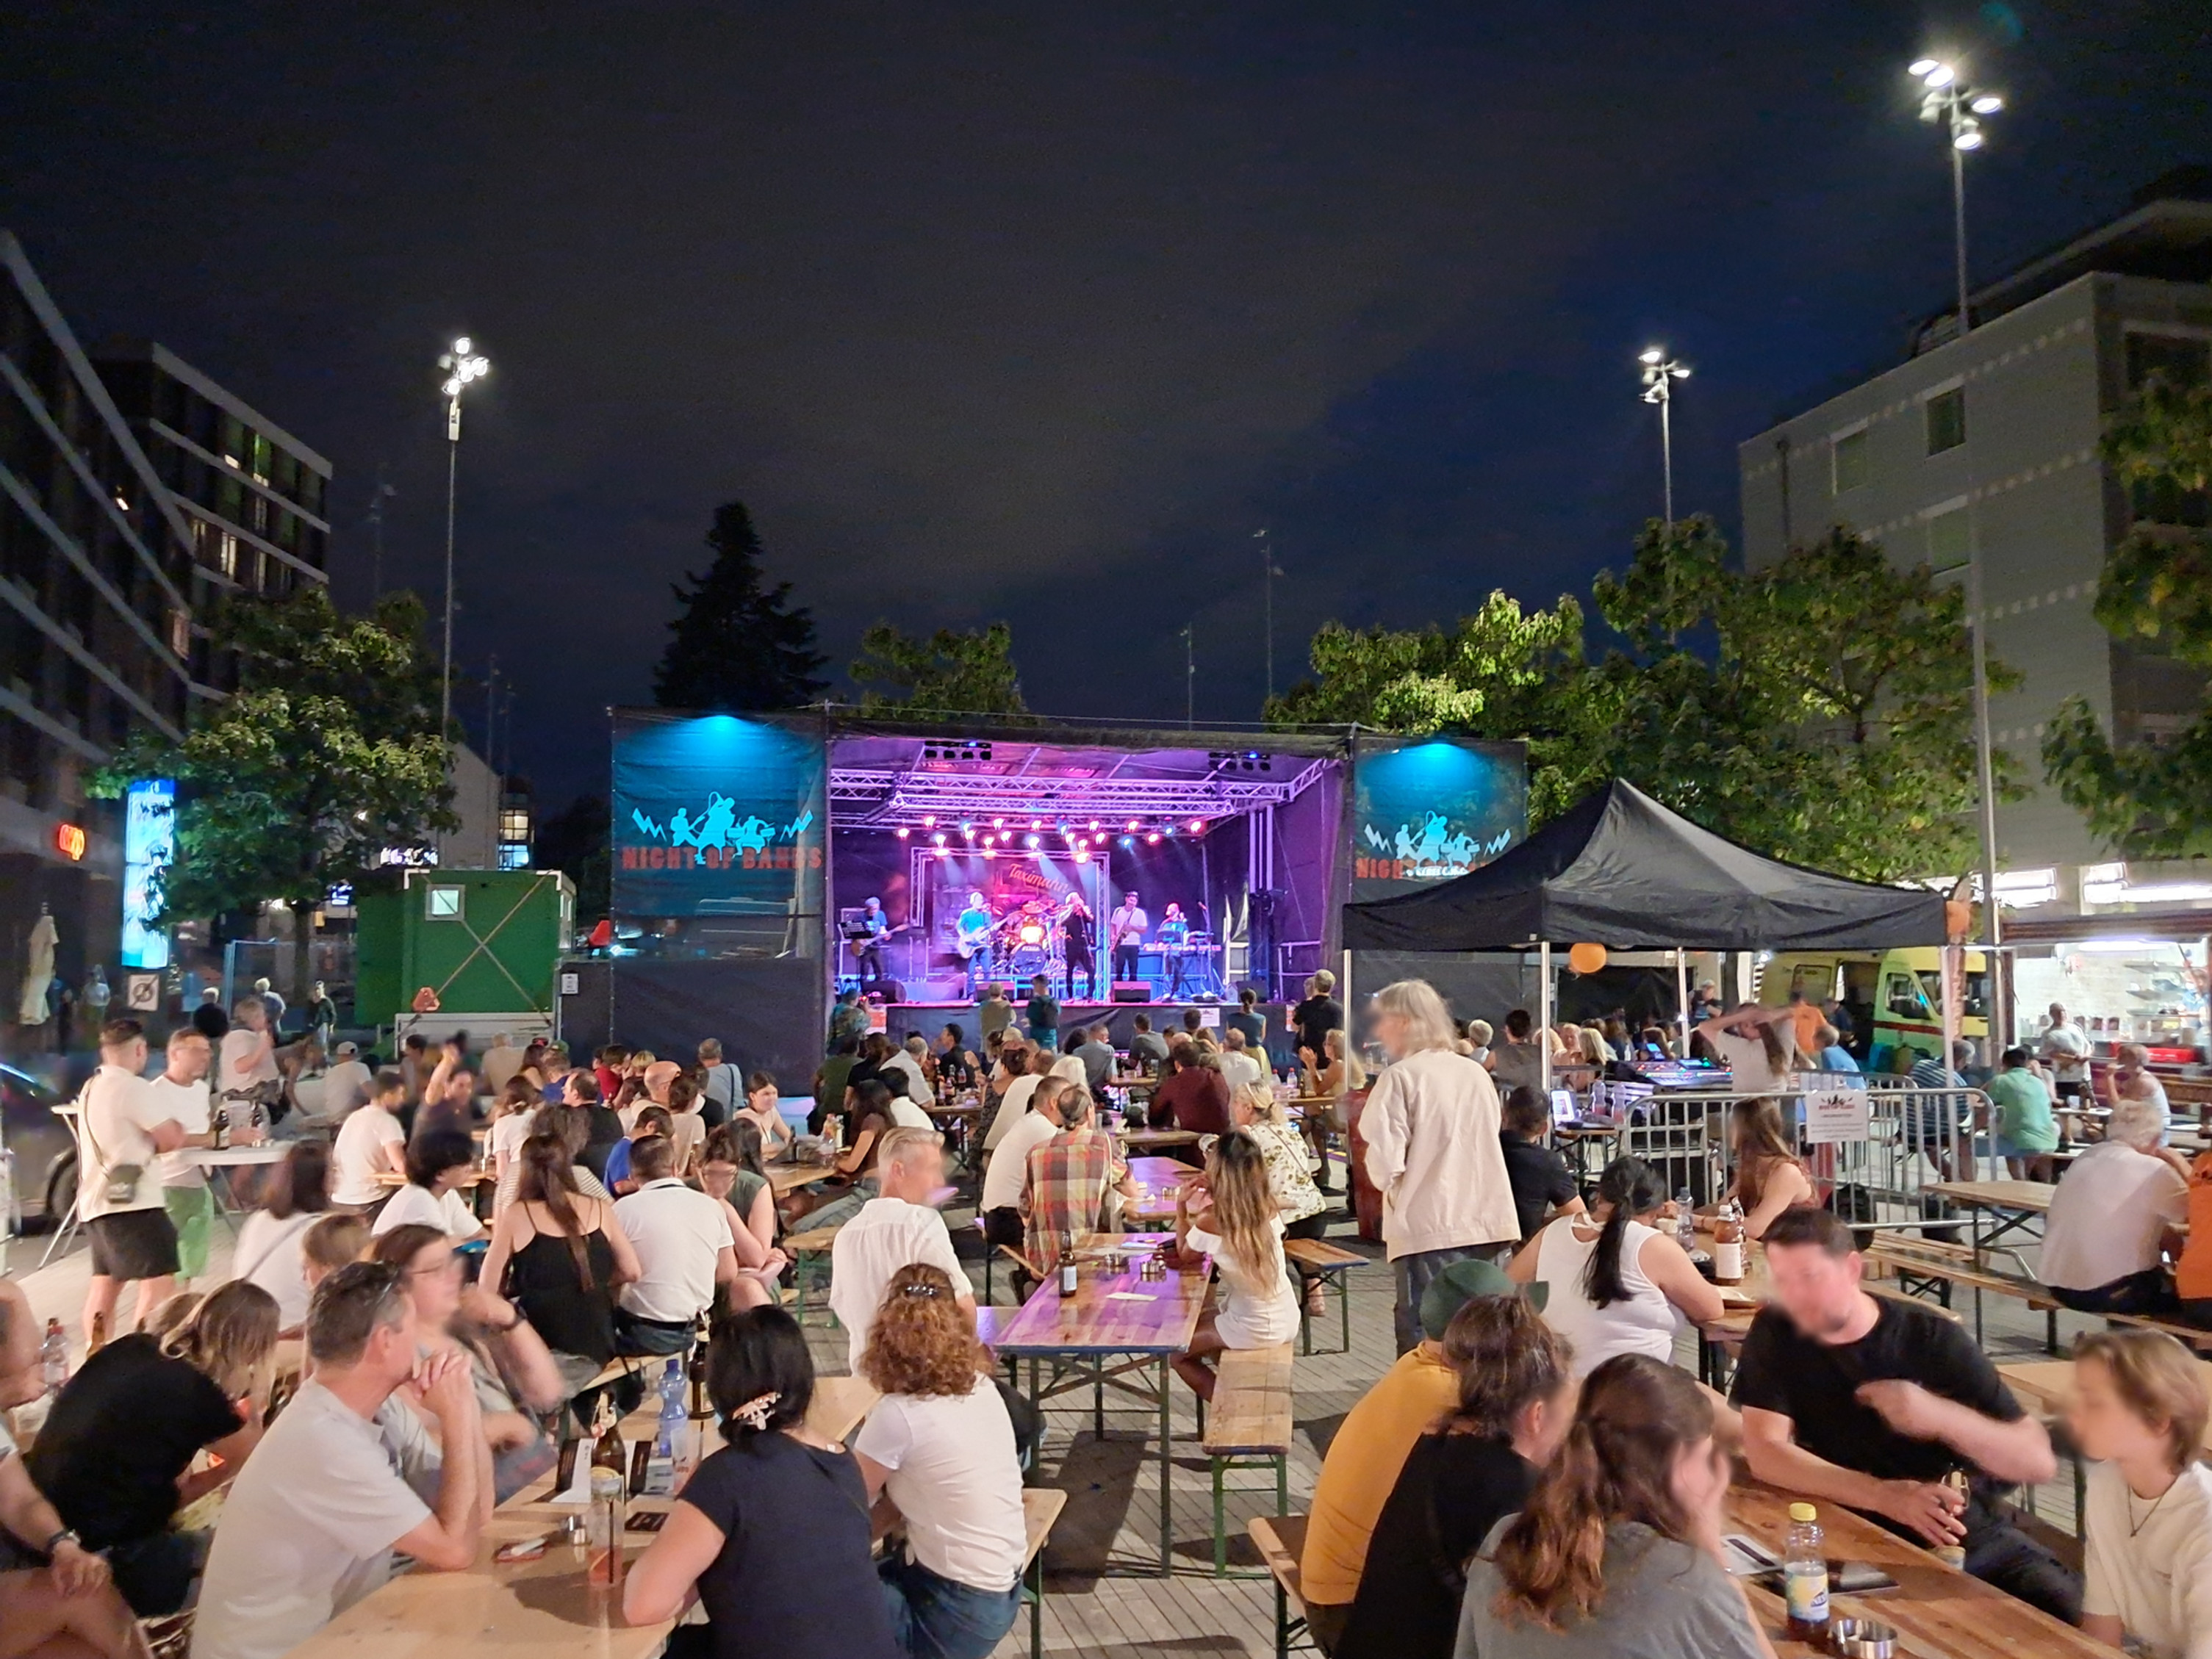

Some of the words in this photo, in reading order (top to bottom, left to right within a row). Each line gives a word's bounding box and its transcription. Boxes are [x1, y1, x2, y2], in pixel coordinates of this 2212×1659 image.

[622, 847, 697, 869] NIGHT
[705, 847, 734, 869] OF
[742, 847, 822, 869] BANDS
